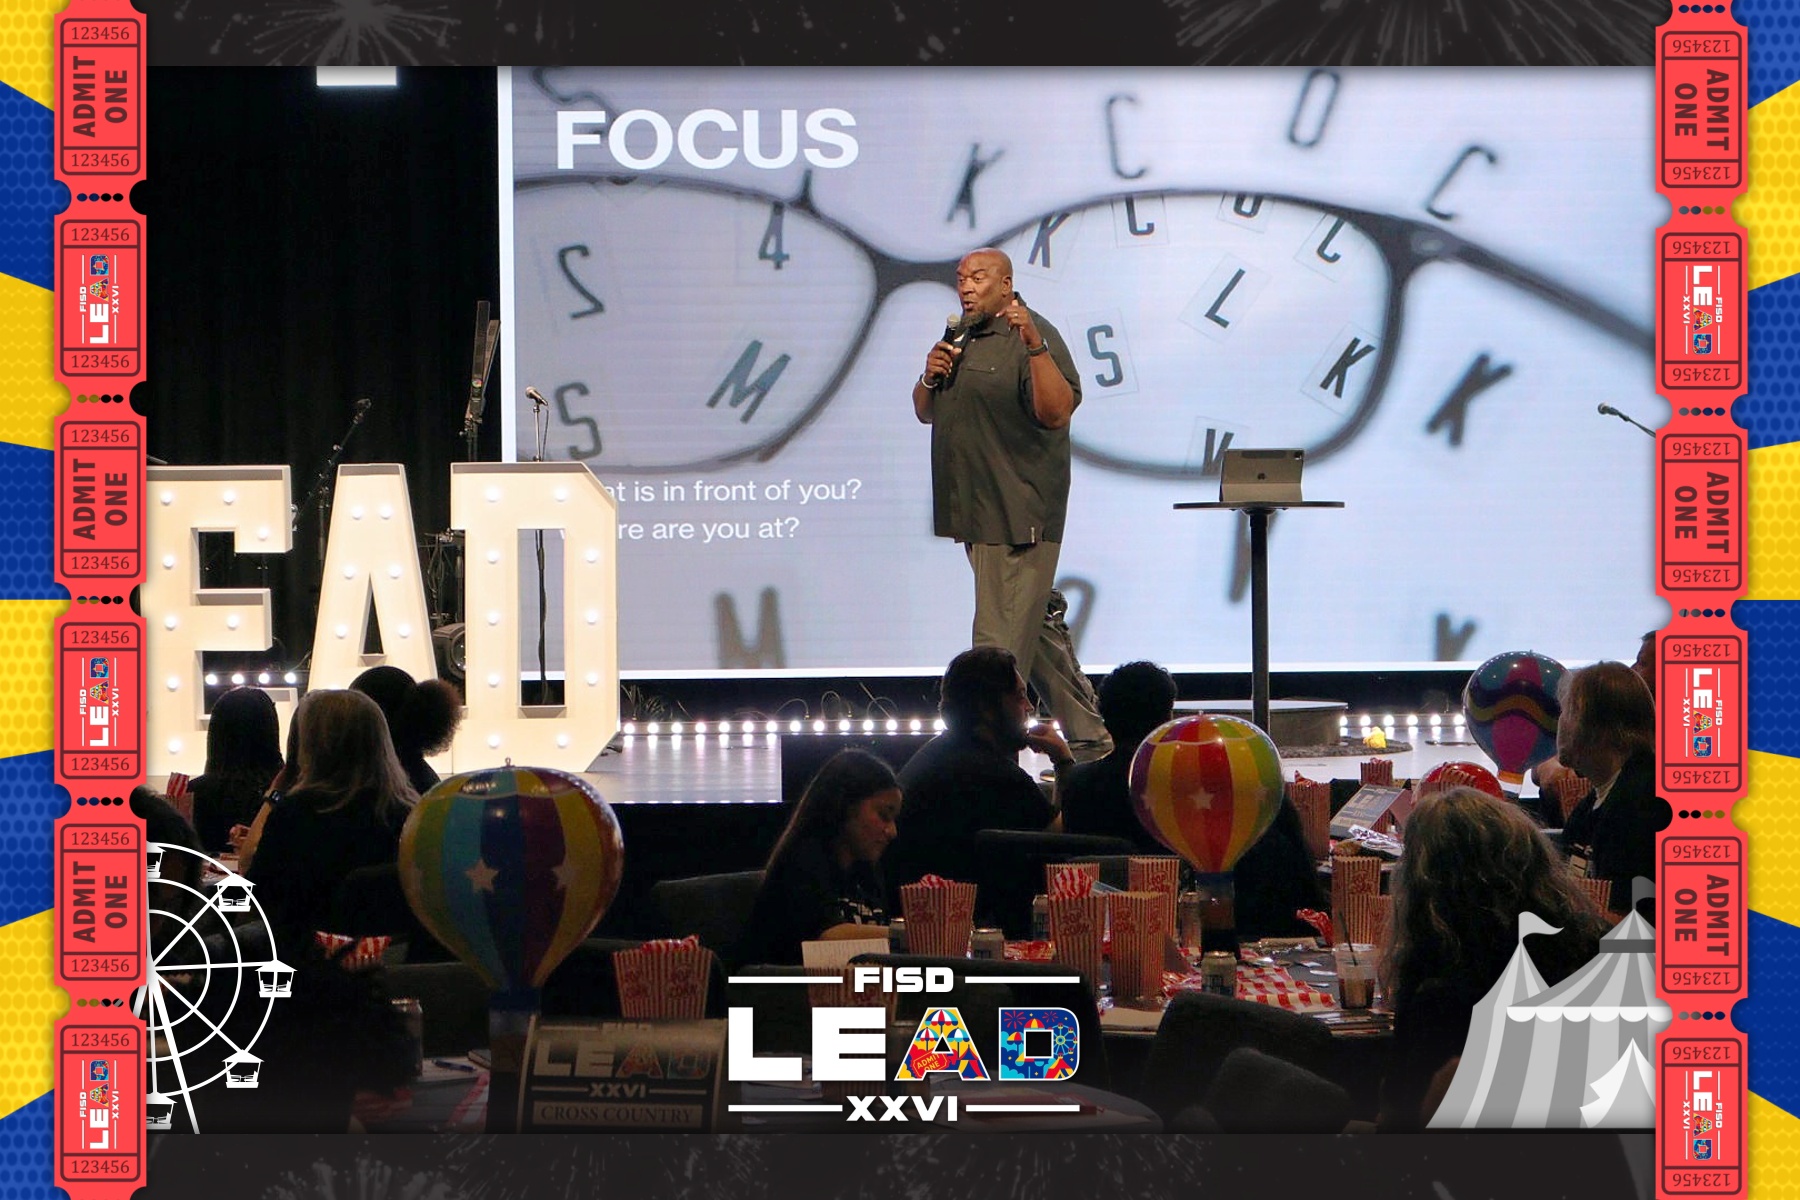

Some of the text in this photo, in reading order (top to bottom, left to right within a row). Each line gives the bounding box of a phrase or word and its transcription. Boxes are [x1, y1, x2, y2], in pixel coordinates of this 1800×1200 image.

[556, 108, 860, 170] FOCUS
[1086, 324, 1124, 388] S
[1319, 336, 1377, 399] K
[634, 481, 656, 502] is
[663, 480, 686, 501] in
[693, 480, 757, 501] front
[764, 479, 791, 501] of
[798, 478, 862, 505] you?
[652, 522, 695, 540] are
[702, 522, 750, 544] you
[758, 517, 800, 539] at?
[589, 1082, 646, 1099] XXVI
[540, 1105, 692, 1125] CROSS COUNTRY
